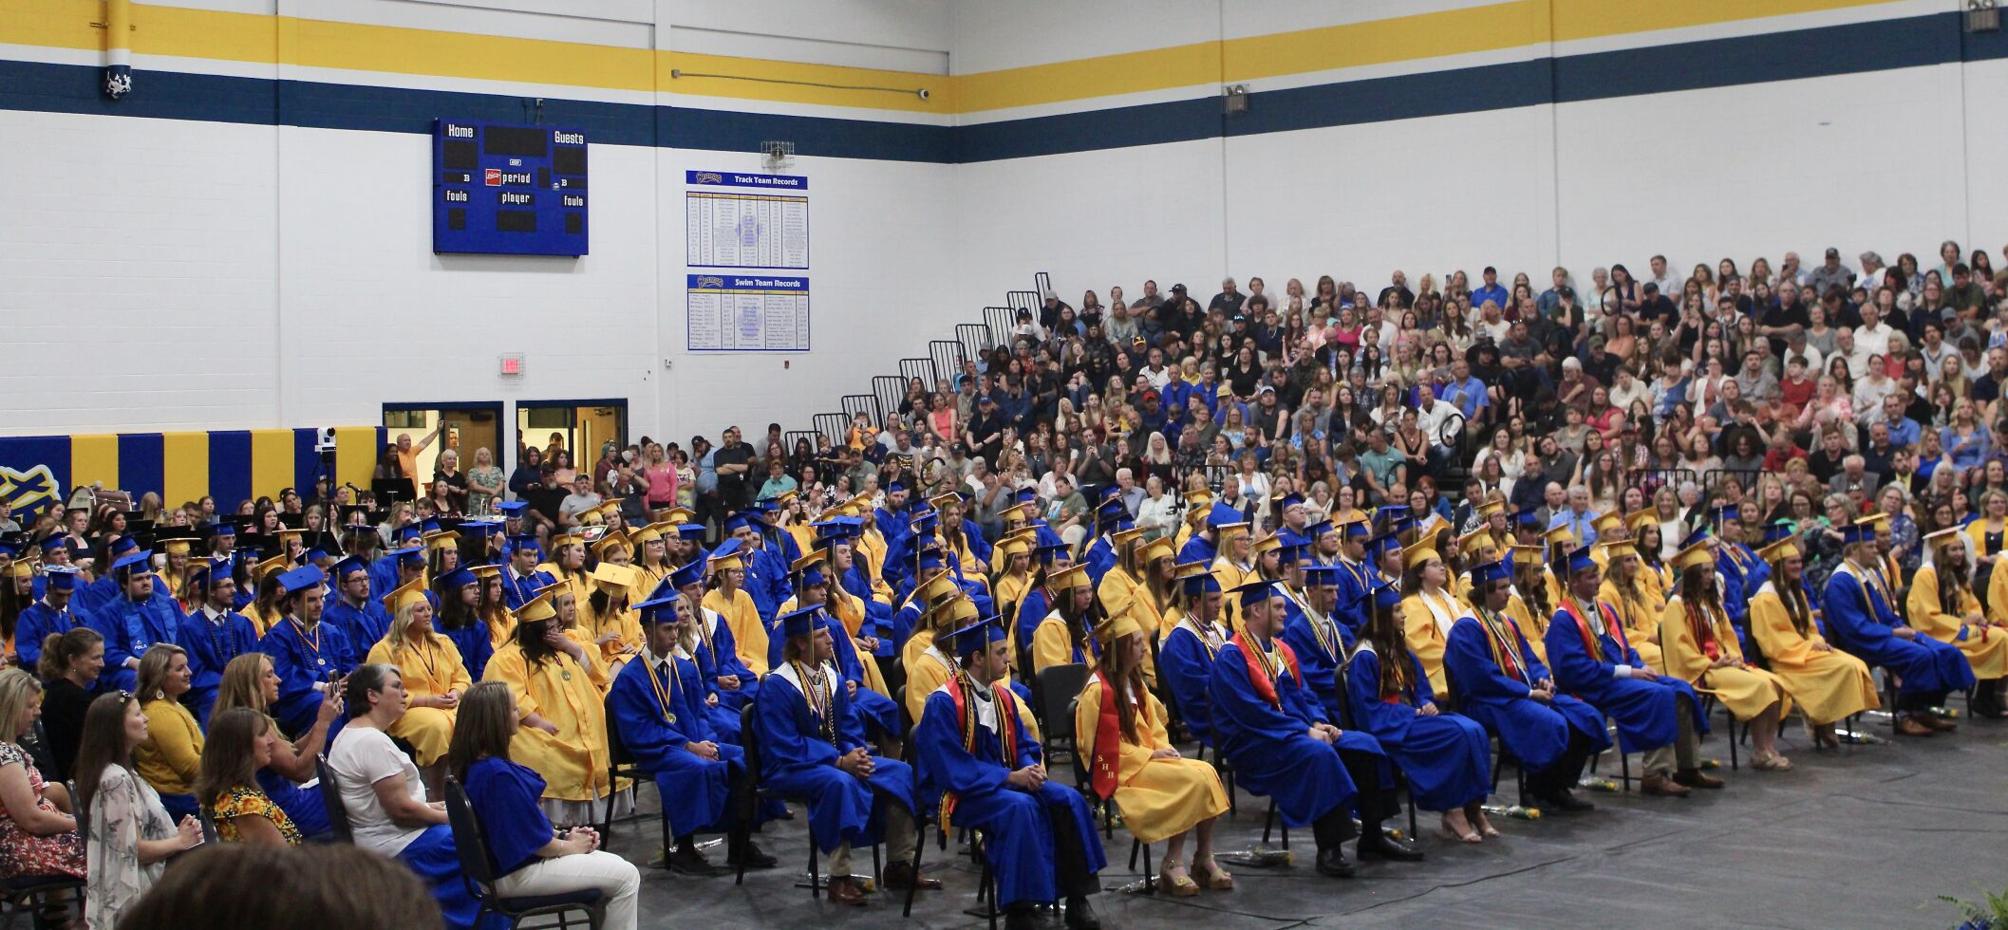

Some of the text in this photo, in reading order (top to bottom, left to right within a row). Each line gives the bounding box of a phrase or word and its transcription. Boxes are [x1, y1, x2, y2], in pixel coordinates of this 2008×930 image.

[448, 124, 473, 138] Home
[554, 130, 584, 144] Guests
[502, 173, 531, 184] period
[734, 175, 798, 186] Track Team Records
[446, 190, 467, 201] fouls
[502, 192, 530, 205] player
[564, 196, 584, 206] fouls
